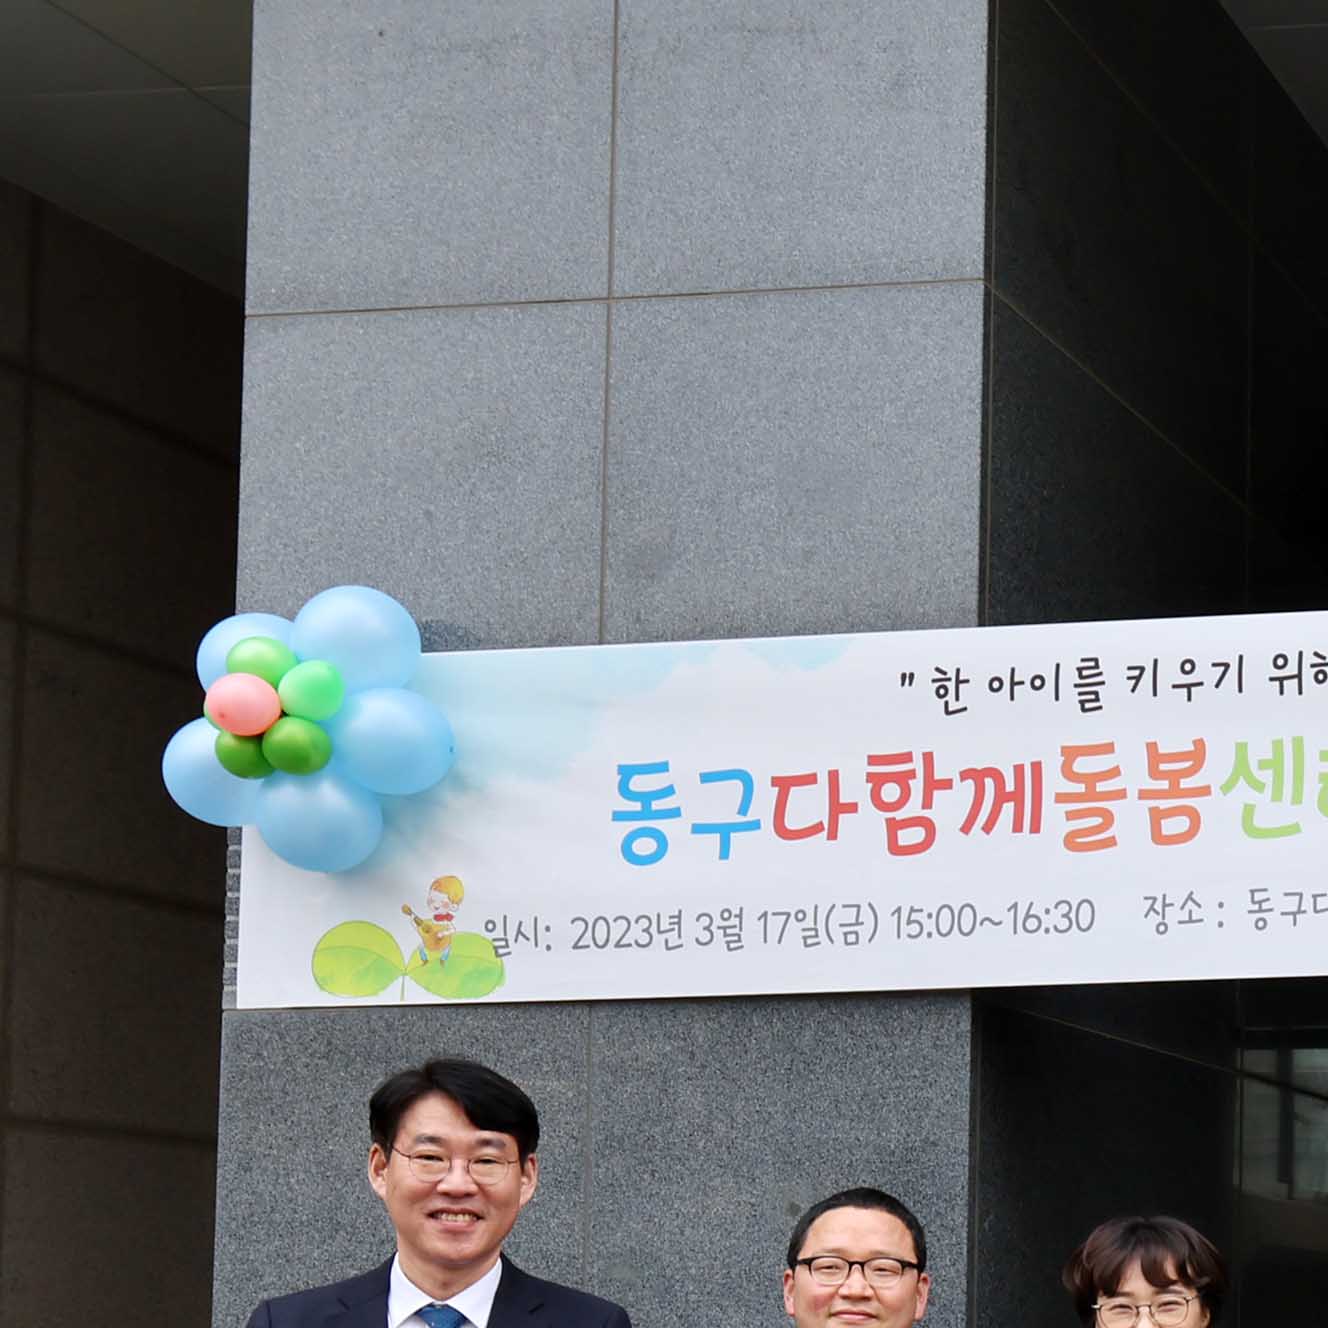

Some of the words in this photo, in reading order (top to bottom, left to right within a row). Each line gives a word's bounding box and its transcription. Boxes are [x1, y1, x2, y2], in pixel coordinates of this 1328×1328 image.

[987, 656, 1107, 714] 아이를
[1125, 653, 1244, 703] 키우기
[484, 914, 552, 959] 일시:
[570, 908, 684, 952] 2023년
[694, 906, 745, 953] 3월
[756, 901, 879, 949] 17일(금)
[890, 898, 1096, 940] 15:00~16:30
